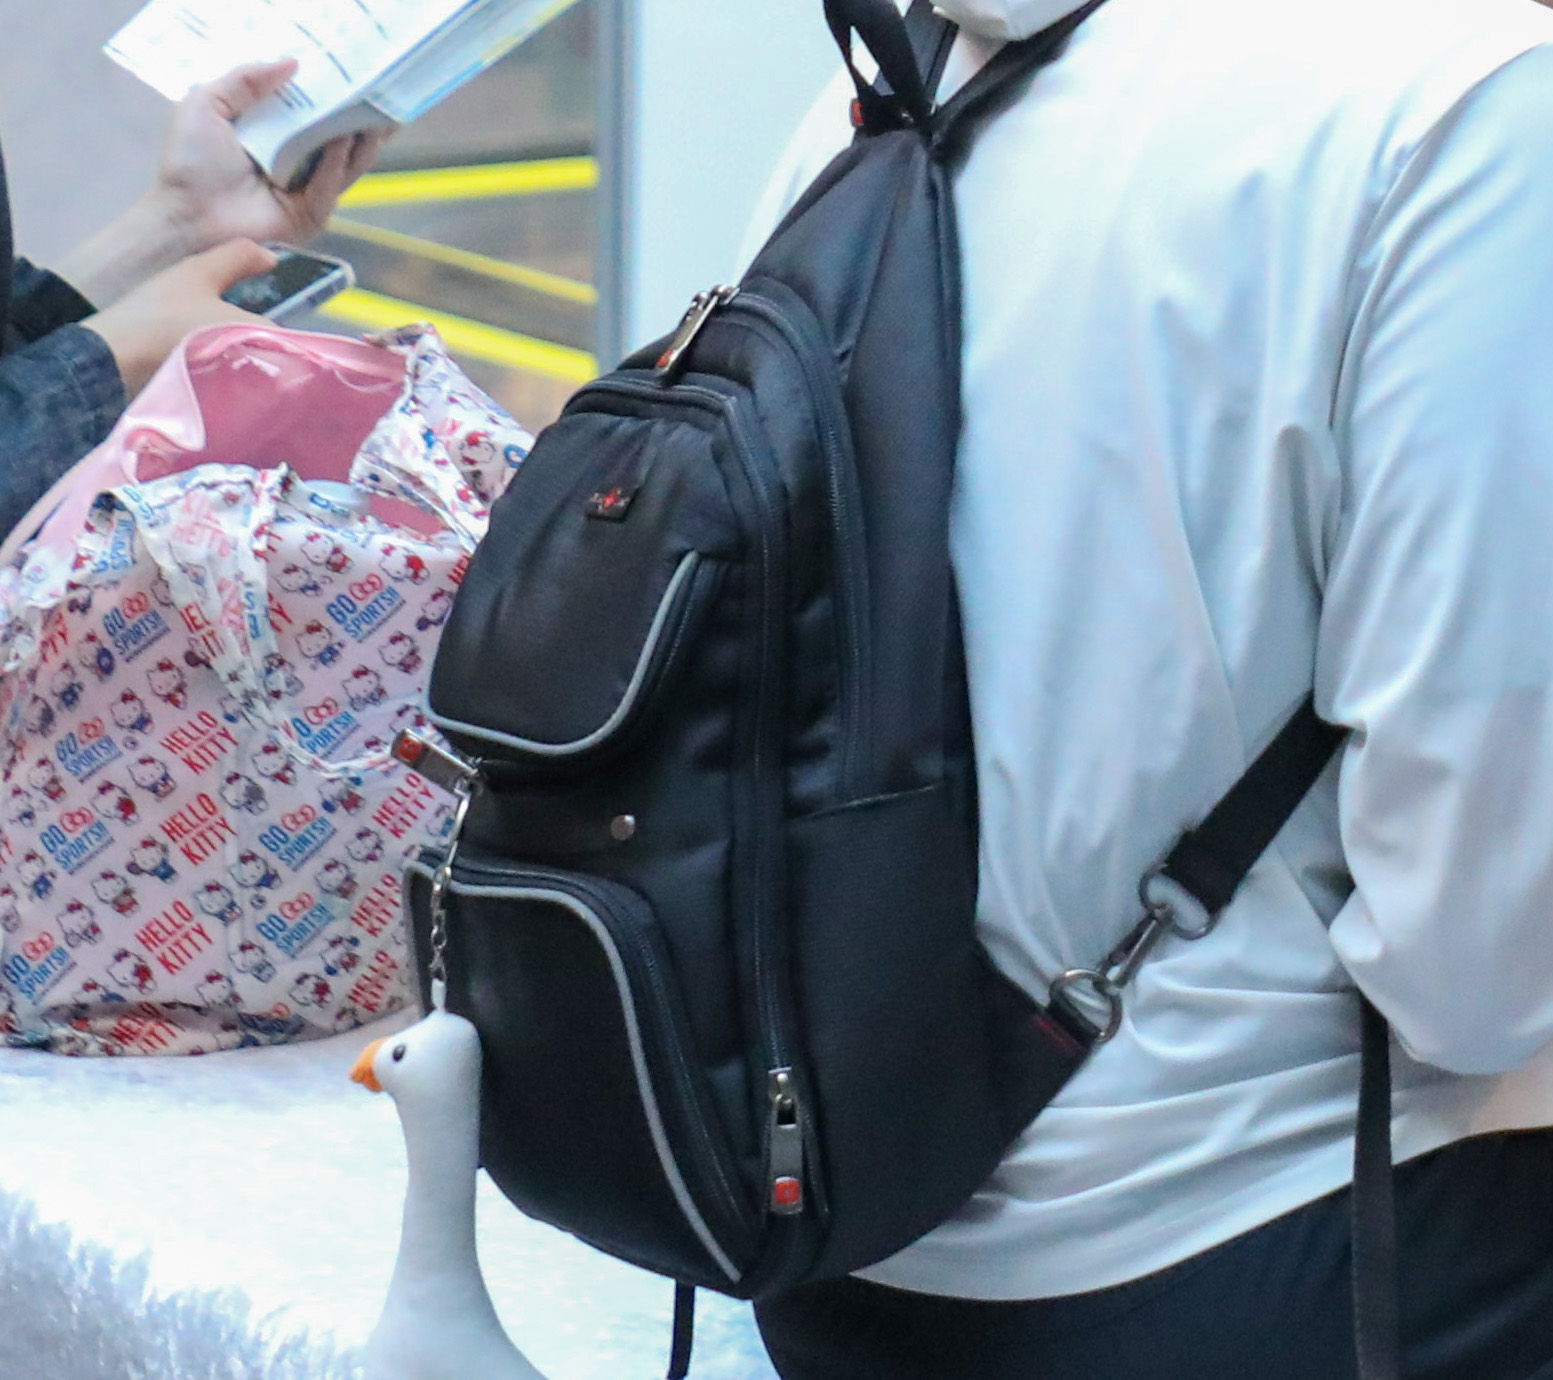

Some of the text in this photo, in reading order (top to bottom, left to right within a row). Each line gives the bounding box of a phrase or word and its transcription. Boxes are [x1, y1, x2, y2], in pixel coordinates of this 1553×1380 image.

[326, 593, 358, 625] GO
[159, 710, 219, 755] HELLO
[181, 726, 240, 776] KITTY
[159, 792, 218, 843] HELLO
[372, 772, 424, 828] HELLO
[388, 786, 435, 840] KITTY
[180, 816, 239, 866] KITTY
[258, 824, 290, 853] GO
[350, 873, 397, 927] HELLO
[134, 900, 195, 953] HELLO
[156, 922, 215, 975] KITTY
[256, 913, 288, 942] GO
